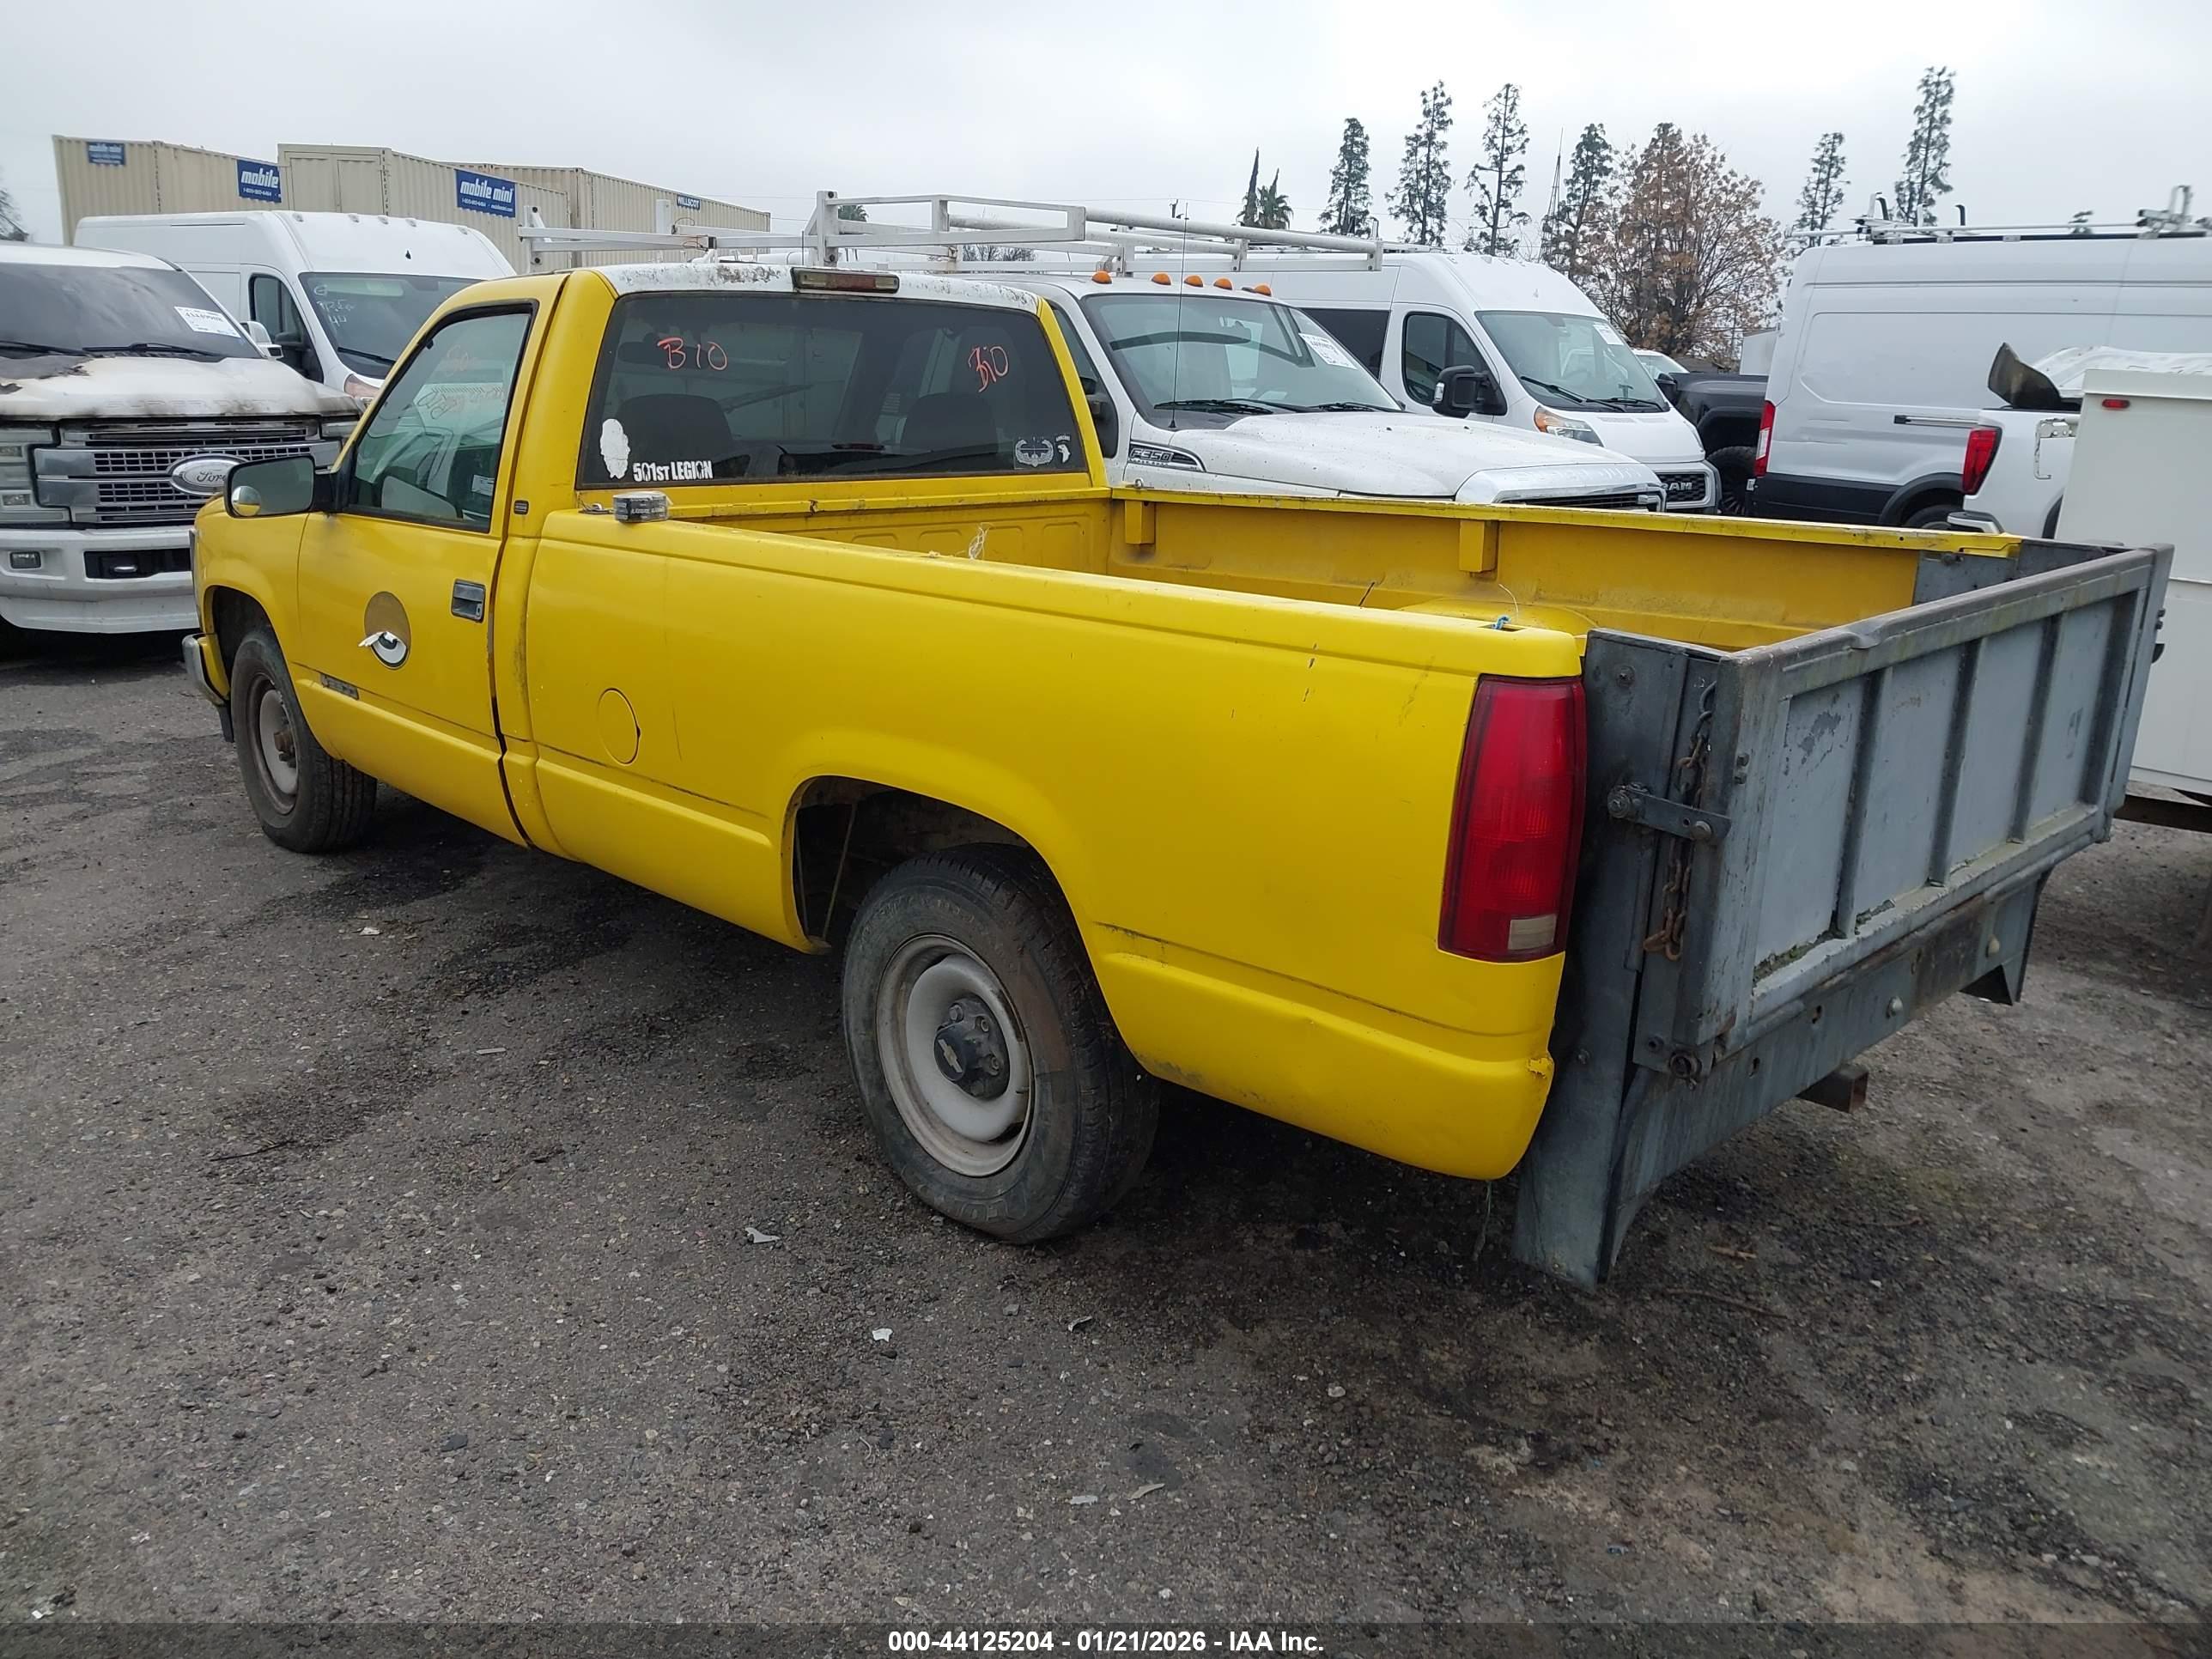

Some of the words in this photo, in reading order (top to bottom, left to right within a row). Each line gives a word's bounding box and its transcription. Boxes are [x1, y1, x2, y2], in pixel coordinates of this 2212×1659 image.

[240, 167, 279, 189] mobile
[459, 178, 493, 199] mobile
[492, 186, 514, 204] mini
[678, 195, 700, 210] WILLSCOT
[1129, 447, 1174, 462] F350
[671, 460, 714, 481] LEGION
